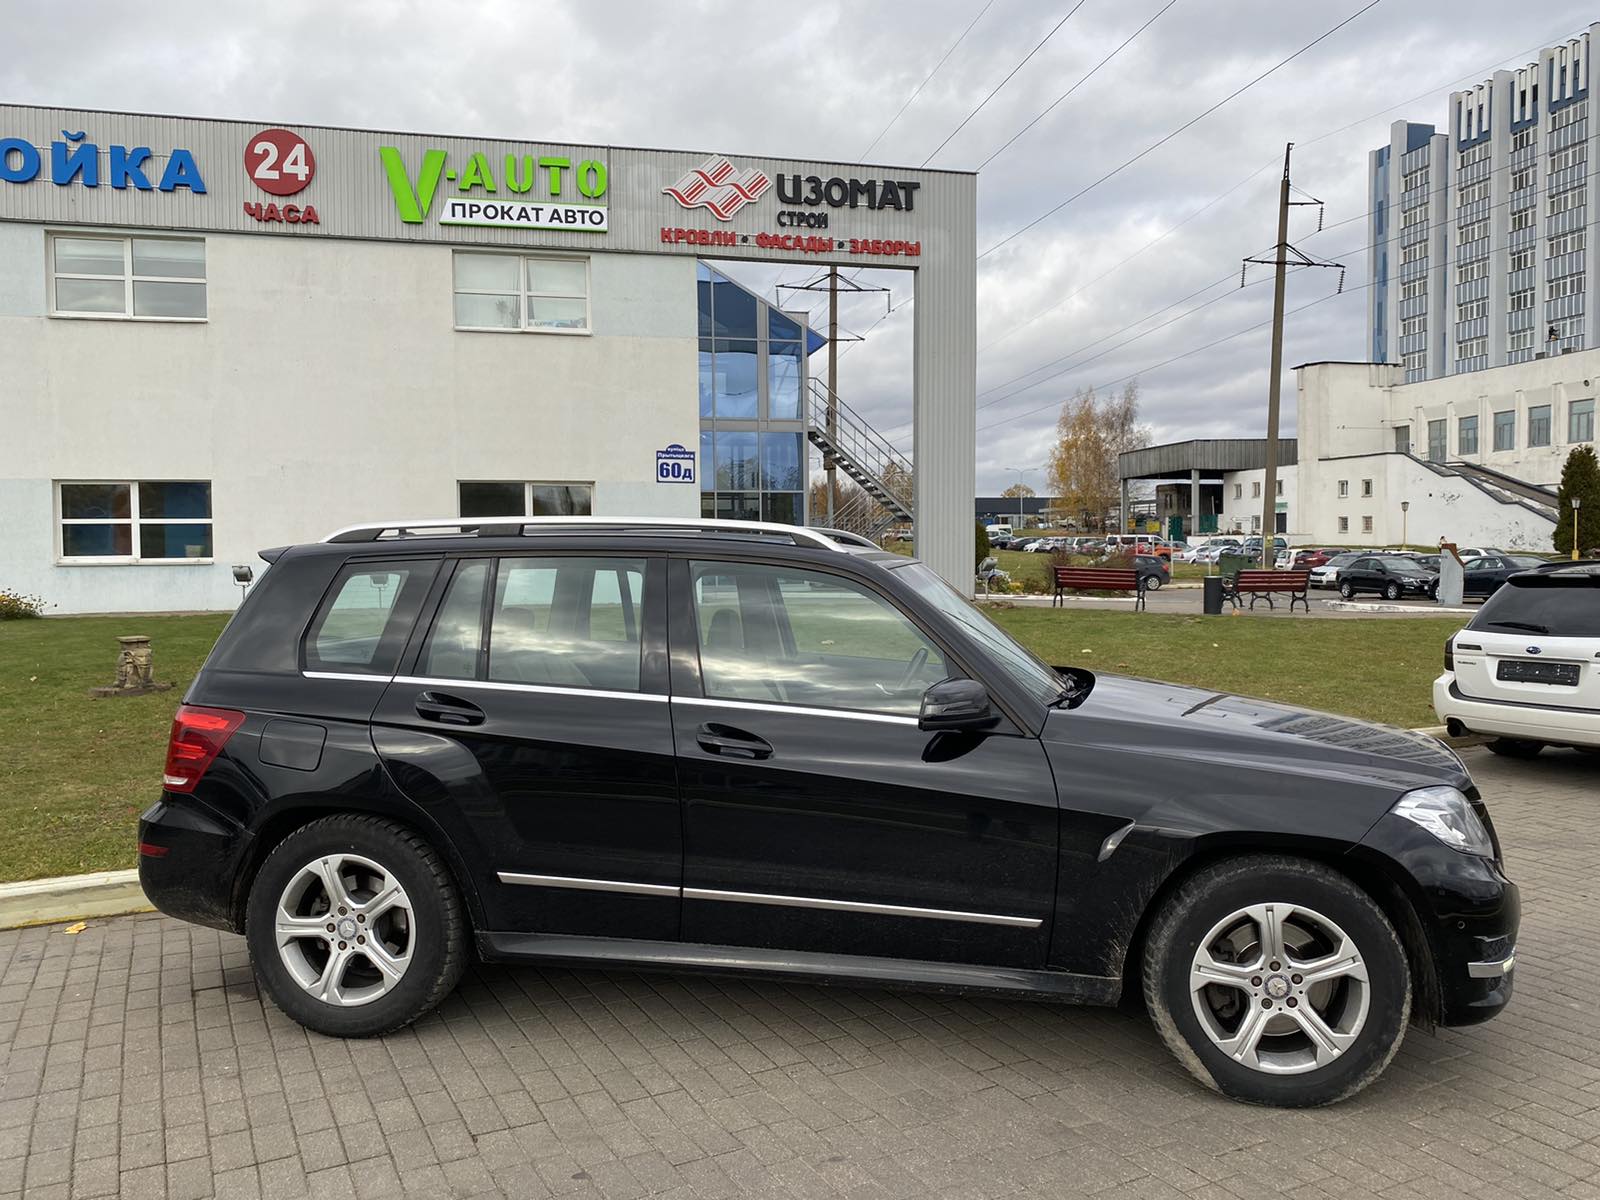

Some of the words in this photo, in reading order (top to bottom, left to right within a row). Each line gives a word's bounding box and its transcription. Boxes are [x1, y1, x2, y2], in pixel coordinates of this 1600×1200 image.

[254, 141, 310, 181] 24
[244, 201, 320, 224] ЧАСА
[451, 203, 543, 223] ПРОКАТ
[548, 208, 605, 226] АВТО
[777, 210, 828, 229] СТРОЙ
[661, 227, 736, 247] КРОВЛИ
[756, 232, 834, 254] ФАСАДЫ
[849, 238, 921, 256] ЗАБОРЫ
